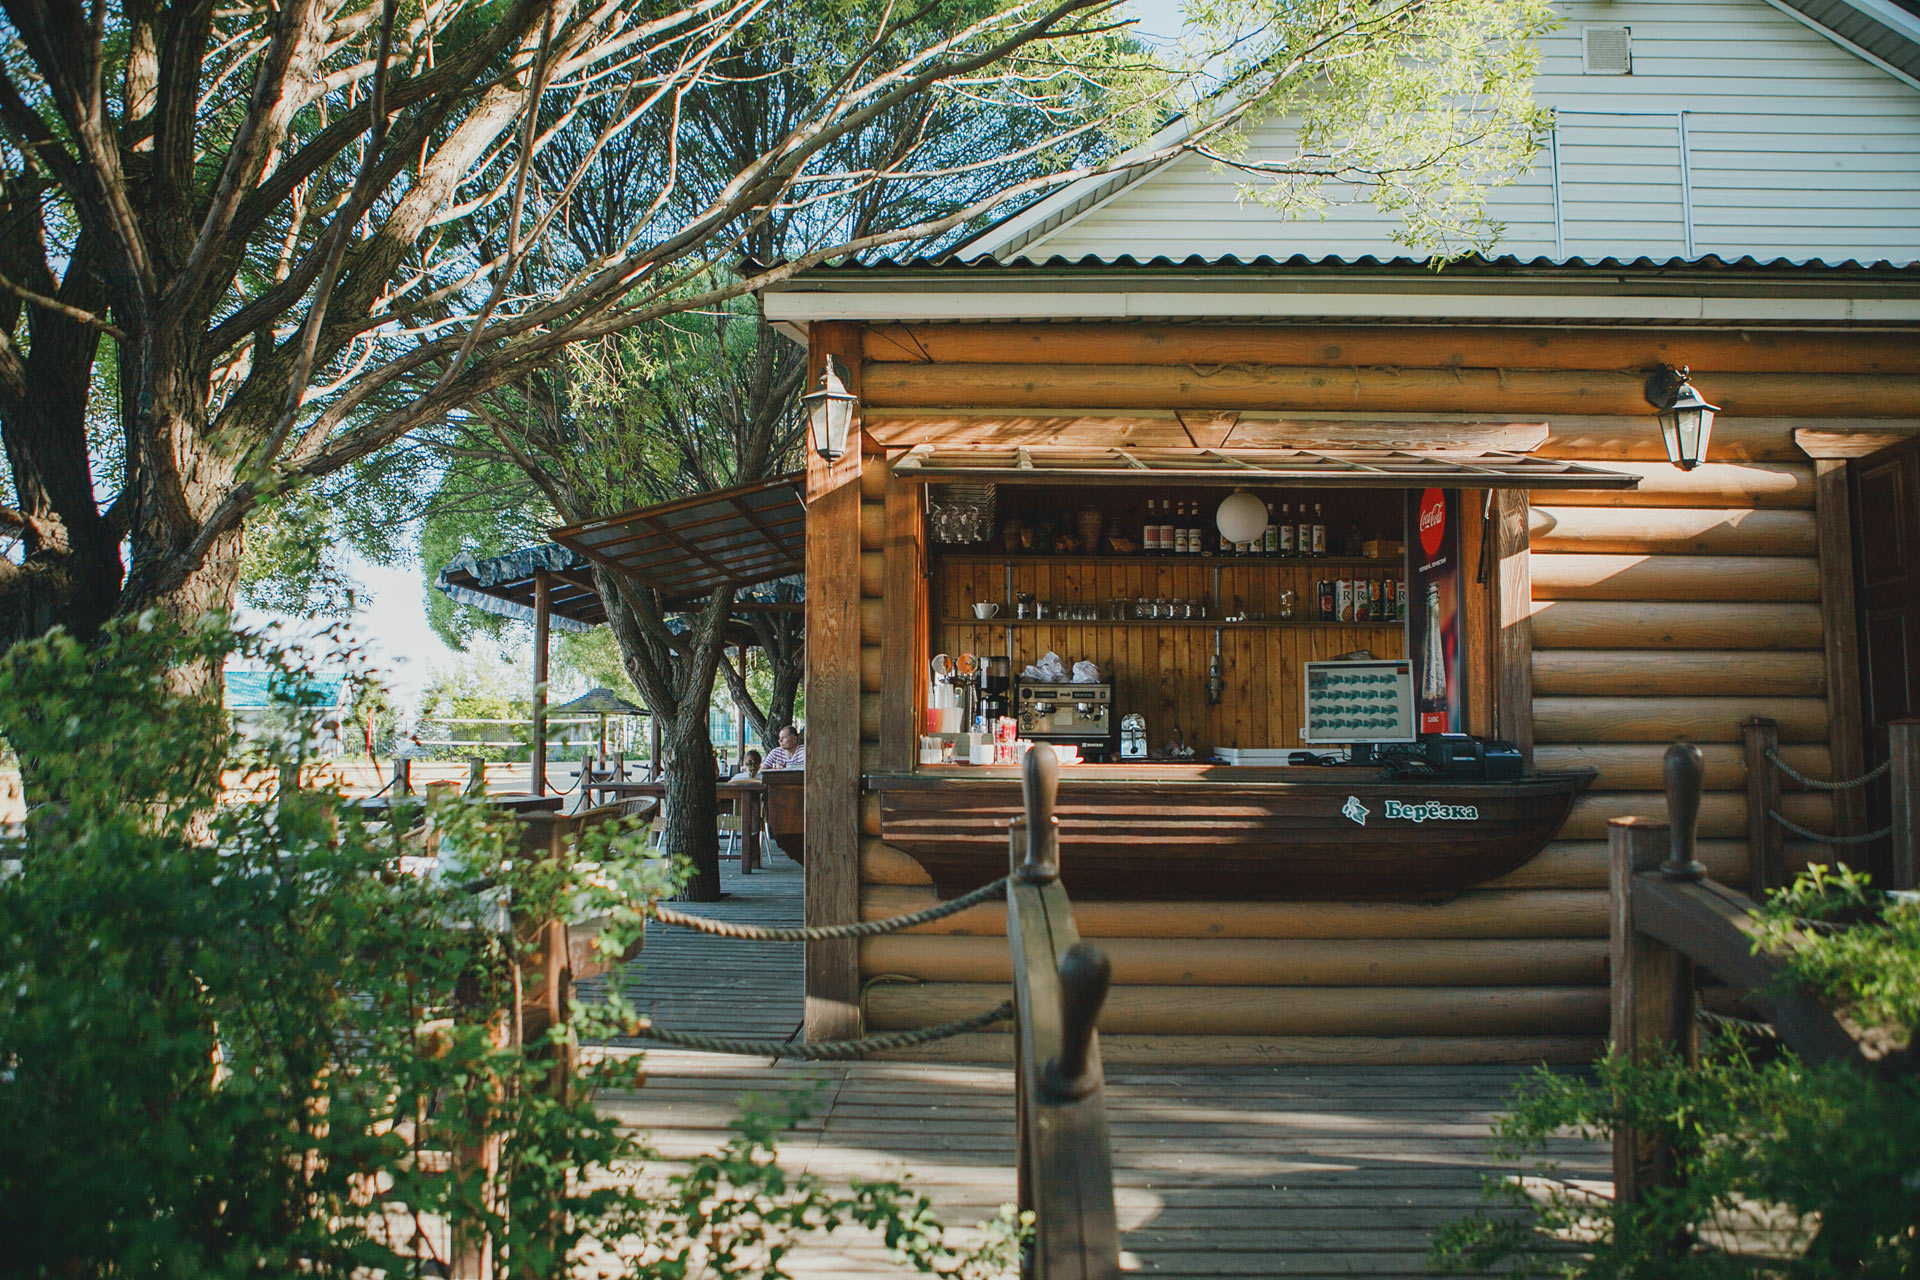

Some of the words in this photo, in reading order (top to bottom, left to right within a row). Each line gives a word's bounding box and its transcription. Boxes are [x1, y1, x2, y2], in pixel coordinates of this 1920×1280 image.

[1343, 590, 1351, 601] R
[1357, 590, 1365, 601] R
[1398, 590, 1406, 601] R
[1385, 800, 1478, 822] Берёзка
